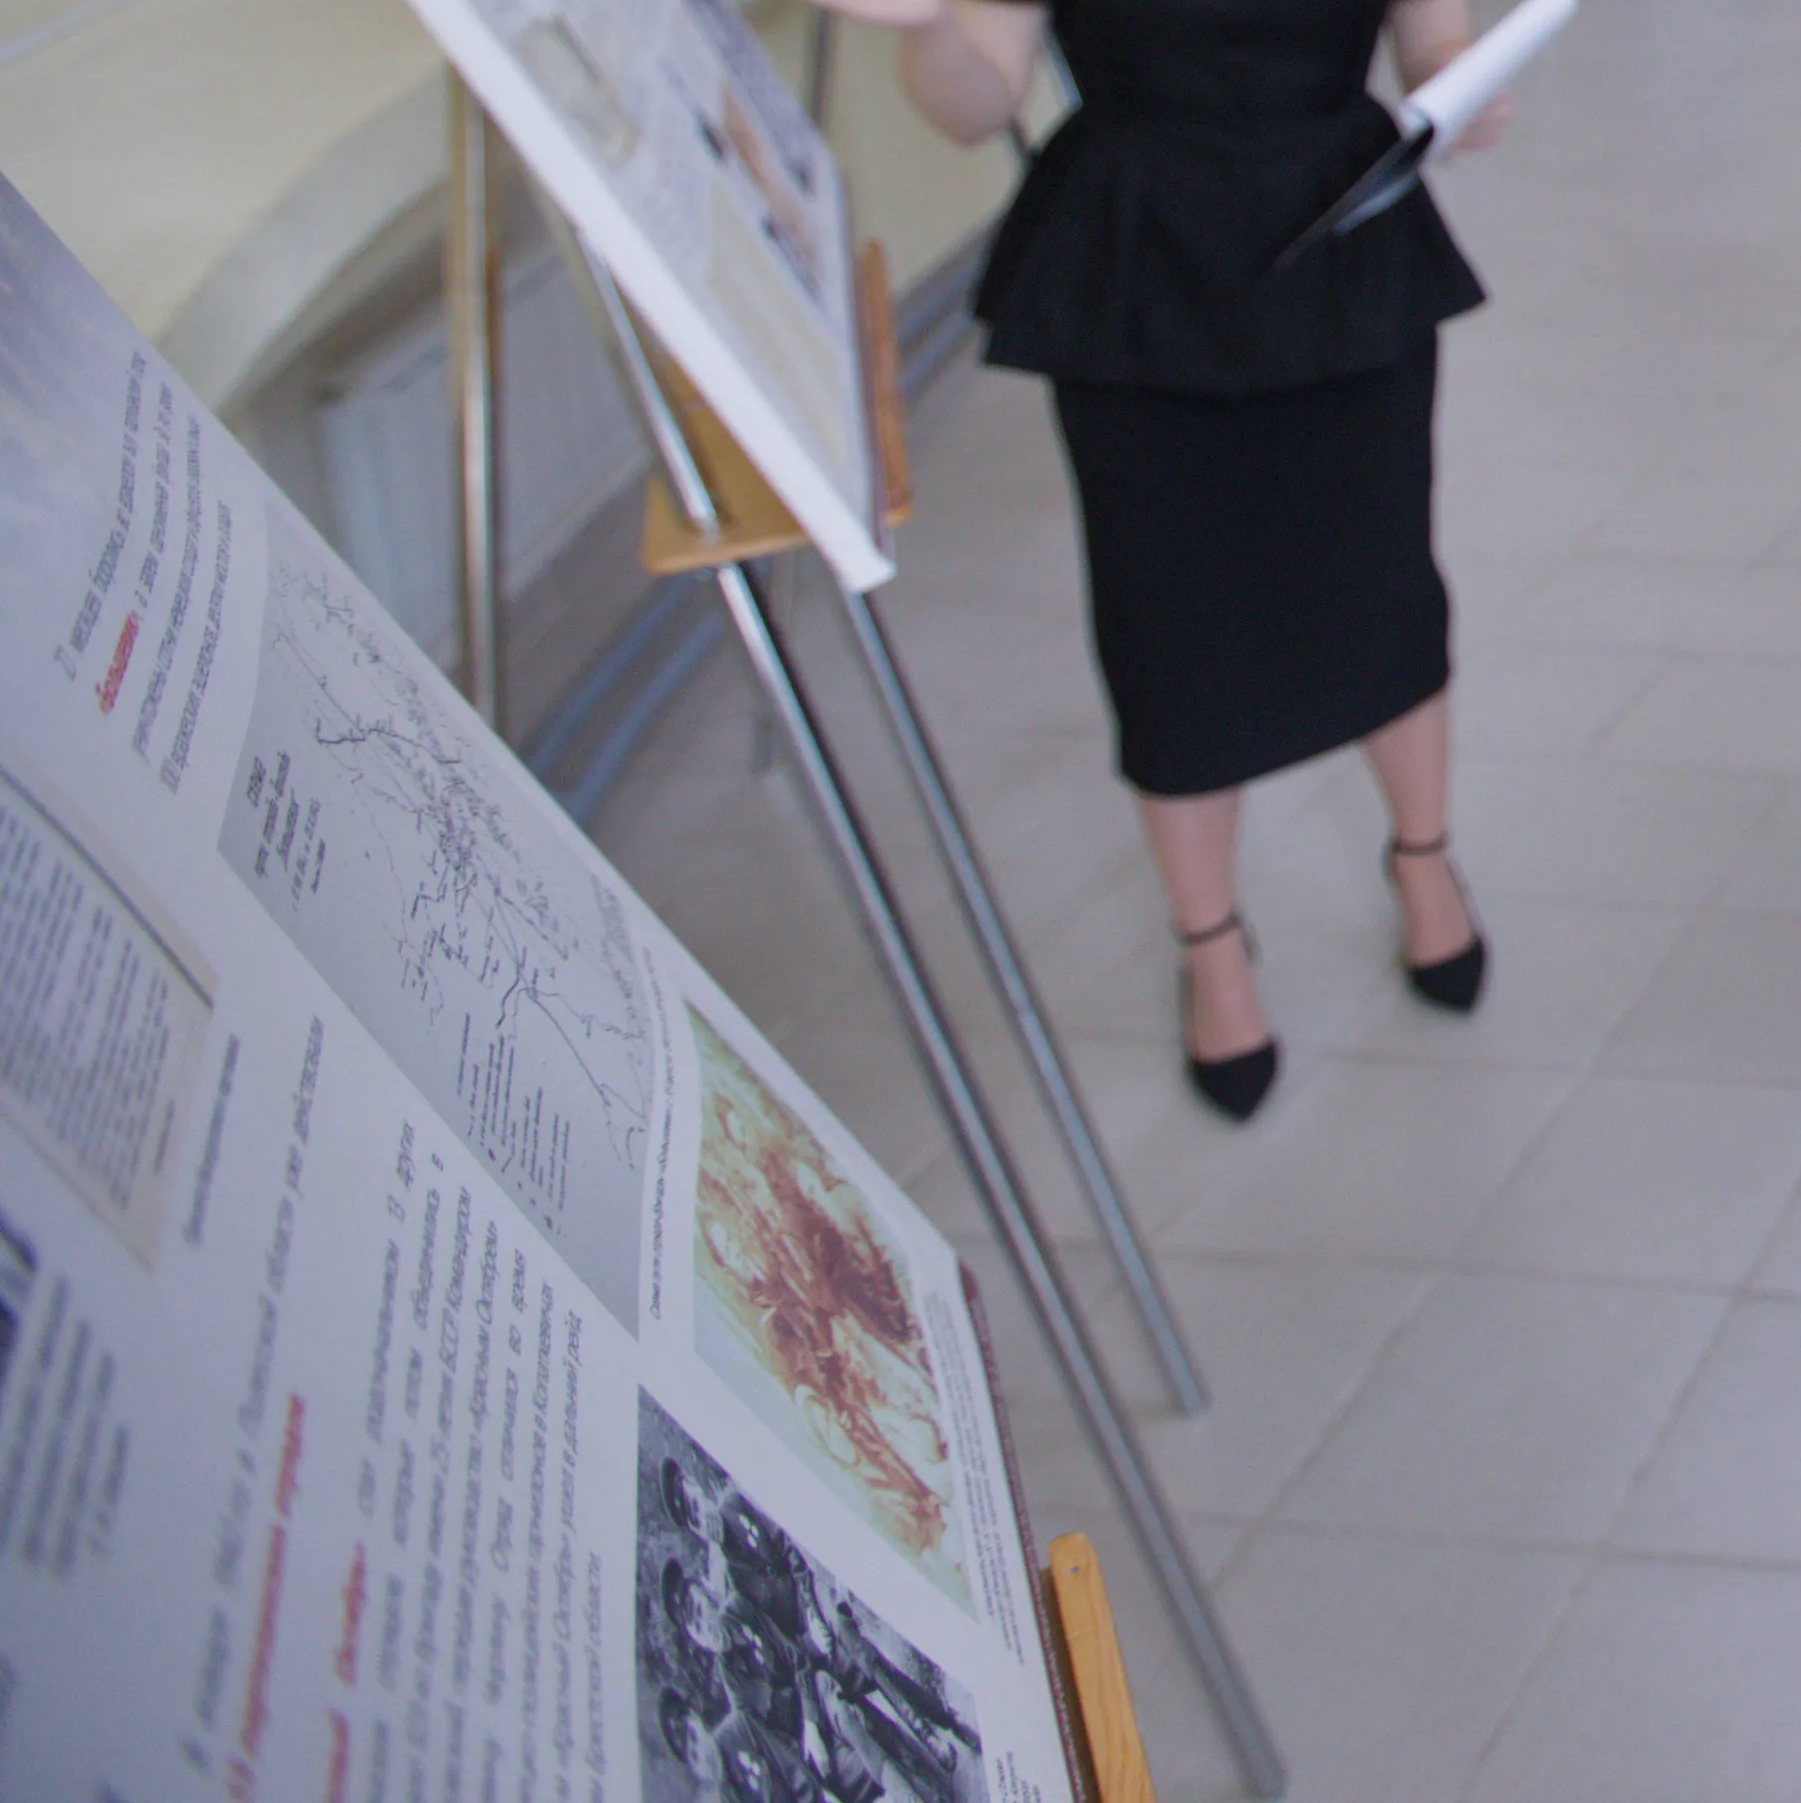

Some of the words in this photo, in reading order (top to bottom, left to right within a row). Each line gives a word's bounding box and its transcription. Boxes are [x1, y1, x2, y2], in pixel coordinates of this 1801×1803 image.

[395, 1121, 415, 1190] других
[444, 1187, 470, 1313] Командиром
[511, 1249, 527, 1313] время
[508, 1325, 521, 1355] во
[532, 1283, 553, 1416] Копаткевичах
[564, 1310, 582, 1366] рейд
[563, 1359, 578, 1454] дальний
